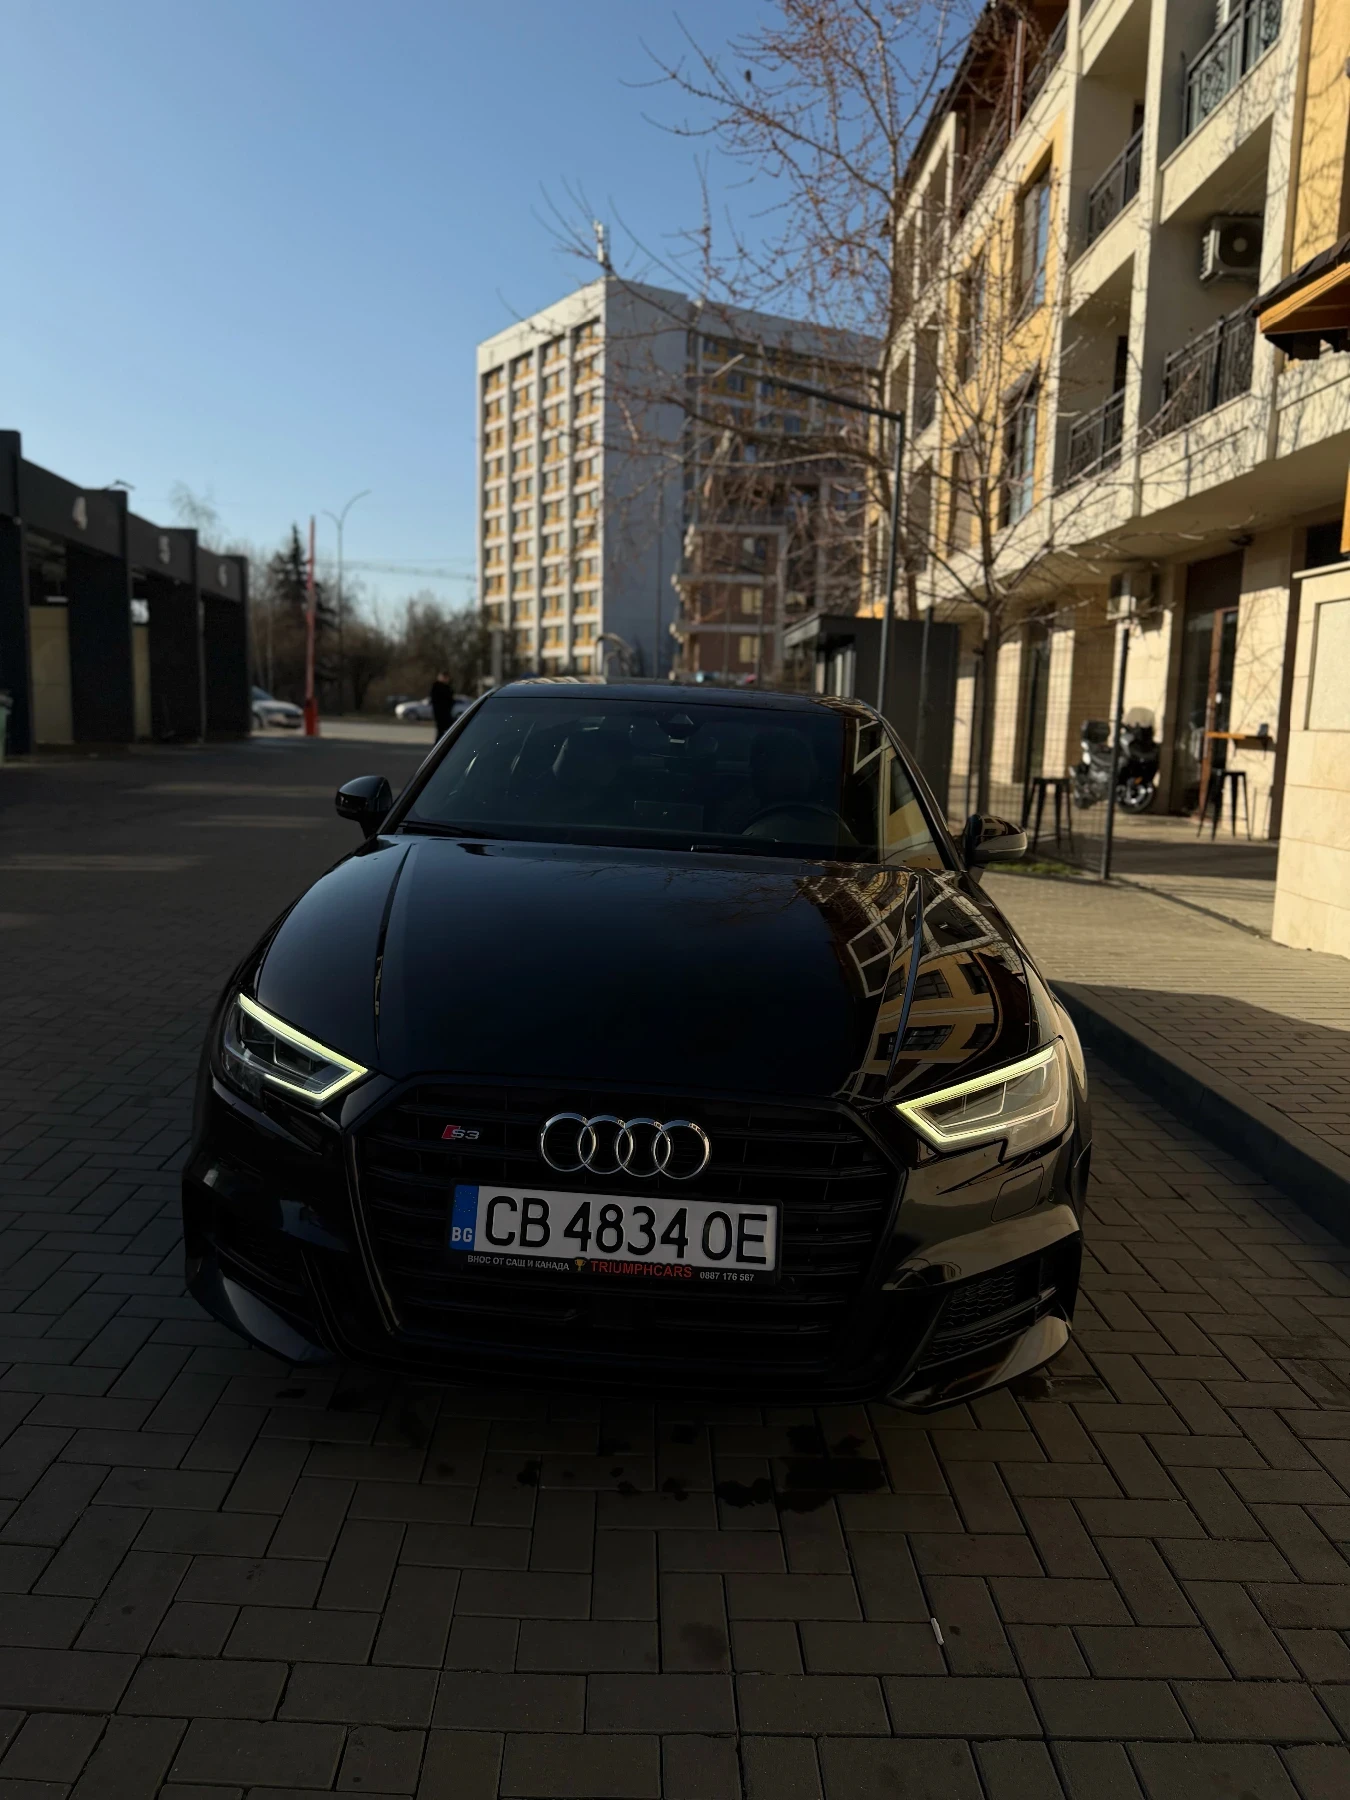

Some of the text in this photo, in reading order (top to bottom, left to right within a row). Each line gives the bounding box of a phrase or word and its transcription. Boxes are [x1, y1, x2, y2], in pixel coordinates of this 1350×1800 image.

[72, 496, 88, 531] 4
[449, 1128, 480, 1140] S3
[451, 1226, 474, 1243] BG
[485, 1195, 551, 1248] CB
[563, 1201, 689, 1259] 4834
[467, 1254, 570, 1271] ВНОС ОТ САЩ И КАНАДА
[590, 1260, 693, 1279] TRIUMPHCARS
[699, 1271, 755, 1282] 0887 176 567
